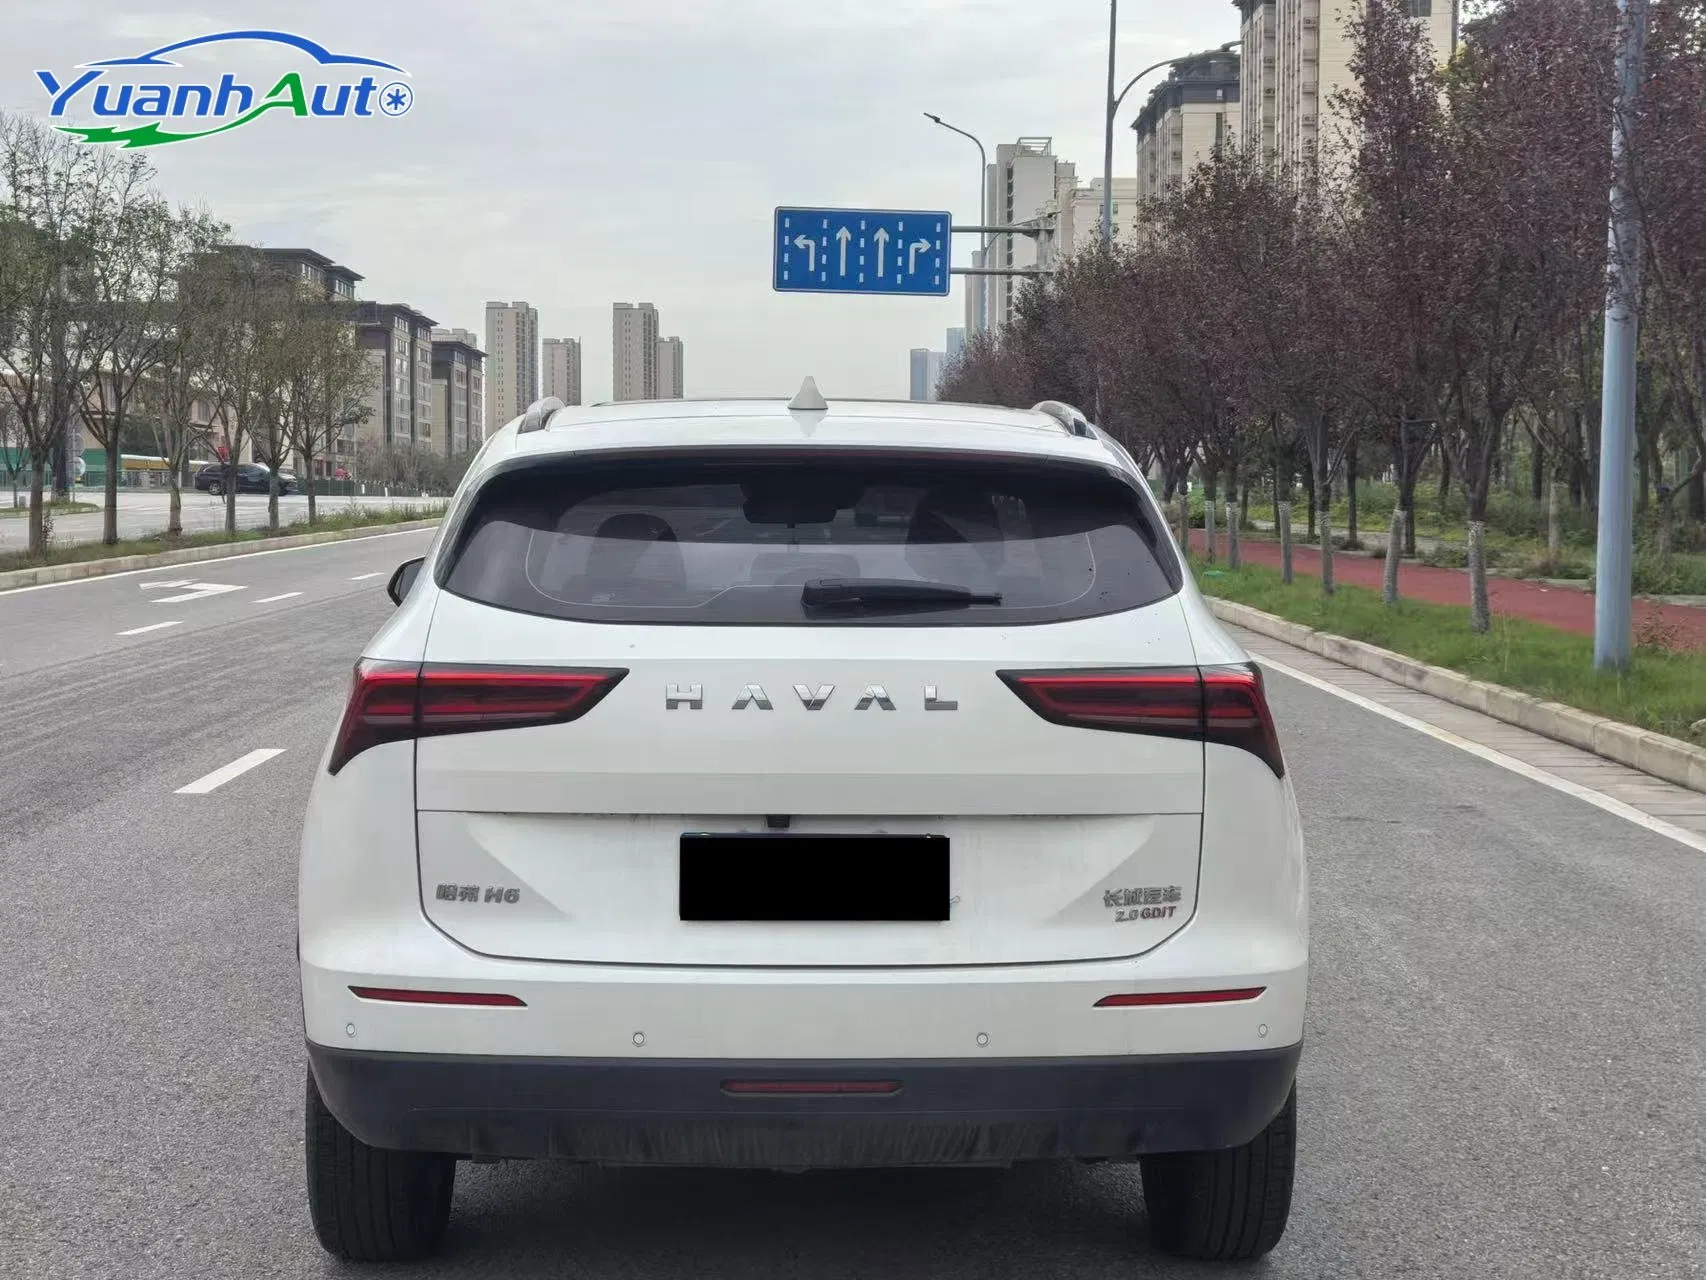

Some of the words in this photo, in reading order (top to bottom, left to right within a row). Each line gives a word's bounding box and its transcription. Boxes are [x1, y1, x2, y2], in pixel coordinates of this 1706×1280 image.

[665, 683, 959, 711] HAVAL
[483, 886, 520, 904] H6
[1103, 885, 1182, 908] 长城汽车
